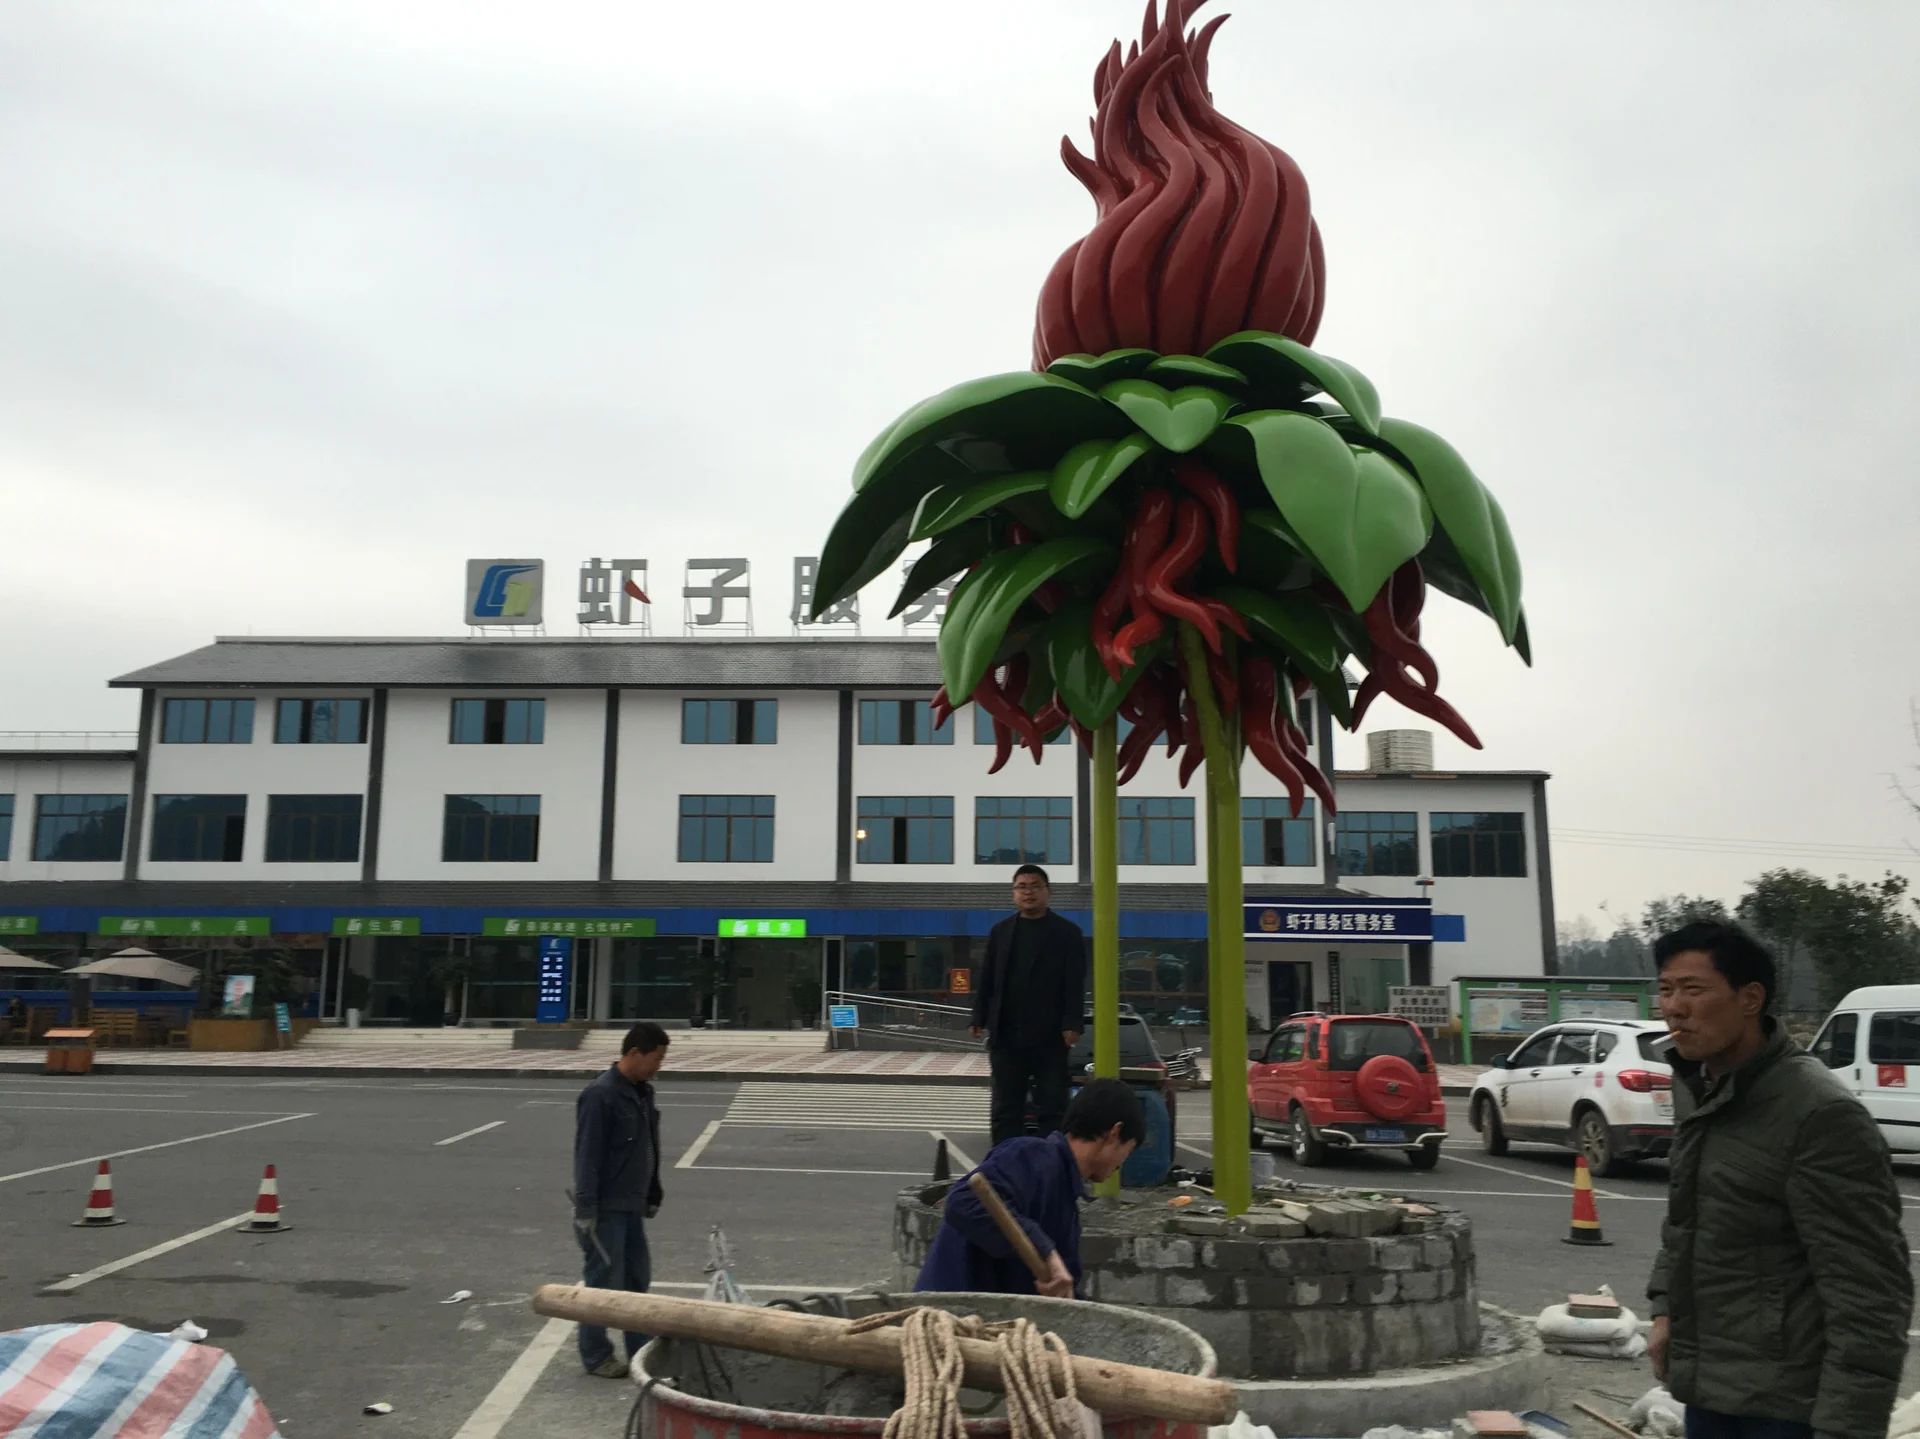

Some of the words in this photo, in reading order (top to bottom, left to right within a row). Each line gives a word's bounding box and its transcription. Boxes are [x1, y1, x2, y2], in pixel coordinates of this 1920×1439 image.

[1286, 913, 1396, 931] 虾子服务区警务室
